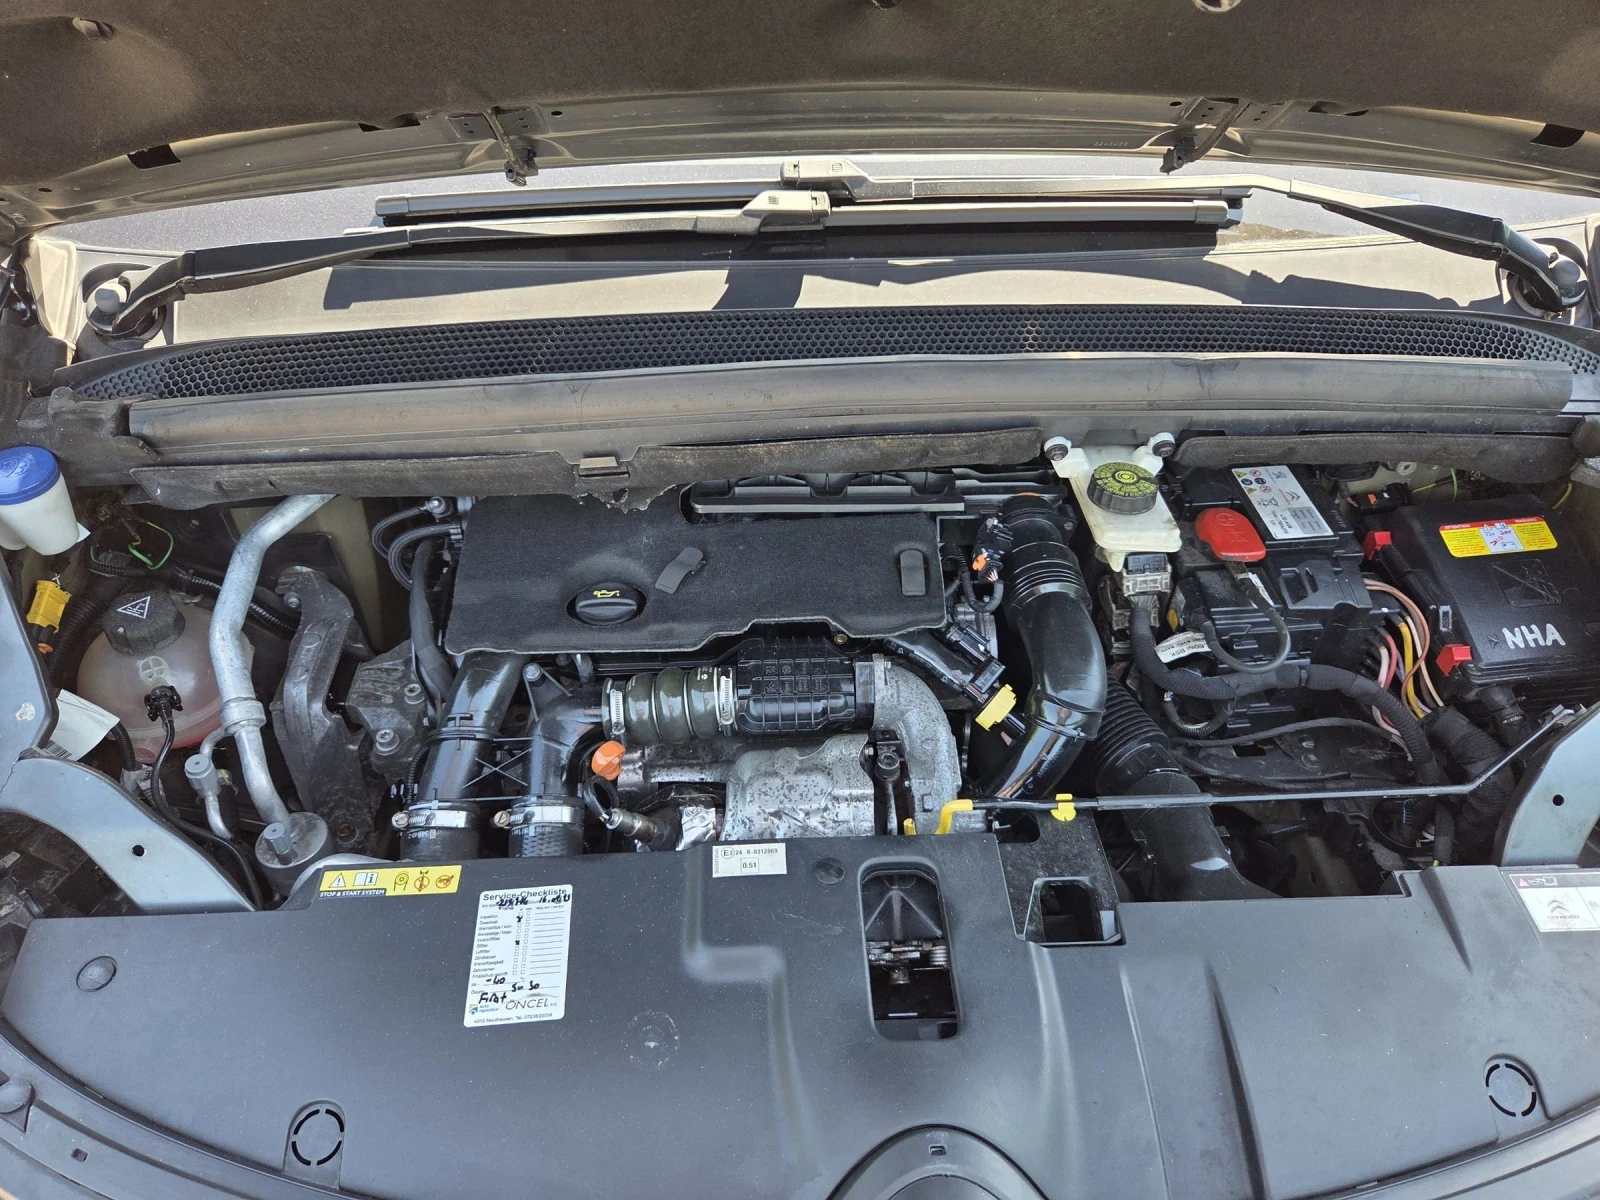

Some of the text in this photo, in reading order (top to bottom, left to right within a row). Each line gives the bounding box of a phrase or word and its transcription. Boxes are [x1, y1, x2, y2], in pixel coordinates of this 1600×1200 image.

[1502, 623, 1566, 649] NHA
[483, 888, 567, 901] Service-Checkliste
[505, 998, 549, 1010] ÖNCEL
